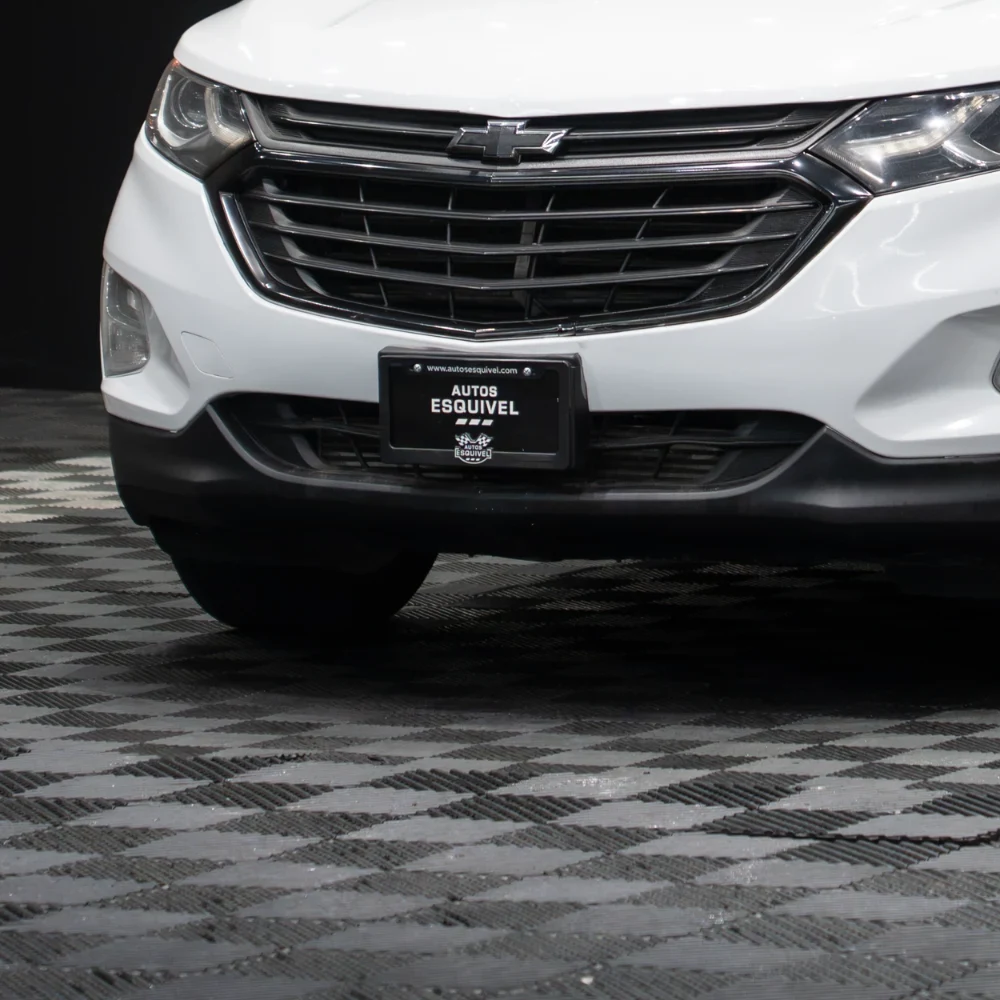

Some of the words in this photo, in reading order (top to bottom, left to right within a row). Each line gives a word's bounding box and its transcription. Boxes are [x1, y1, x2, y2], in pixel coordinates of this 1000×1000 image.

[426, 365, 518, 375] www.autosesquivel.com
[451, 384, 498, 397] AUTOS
[431, 398, 519, 415] ESQUIVEL
[456, 450, 490, 458] ESQUIVEL
